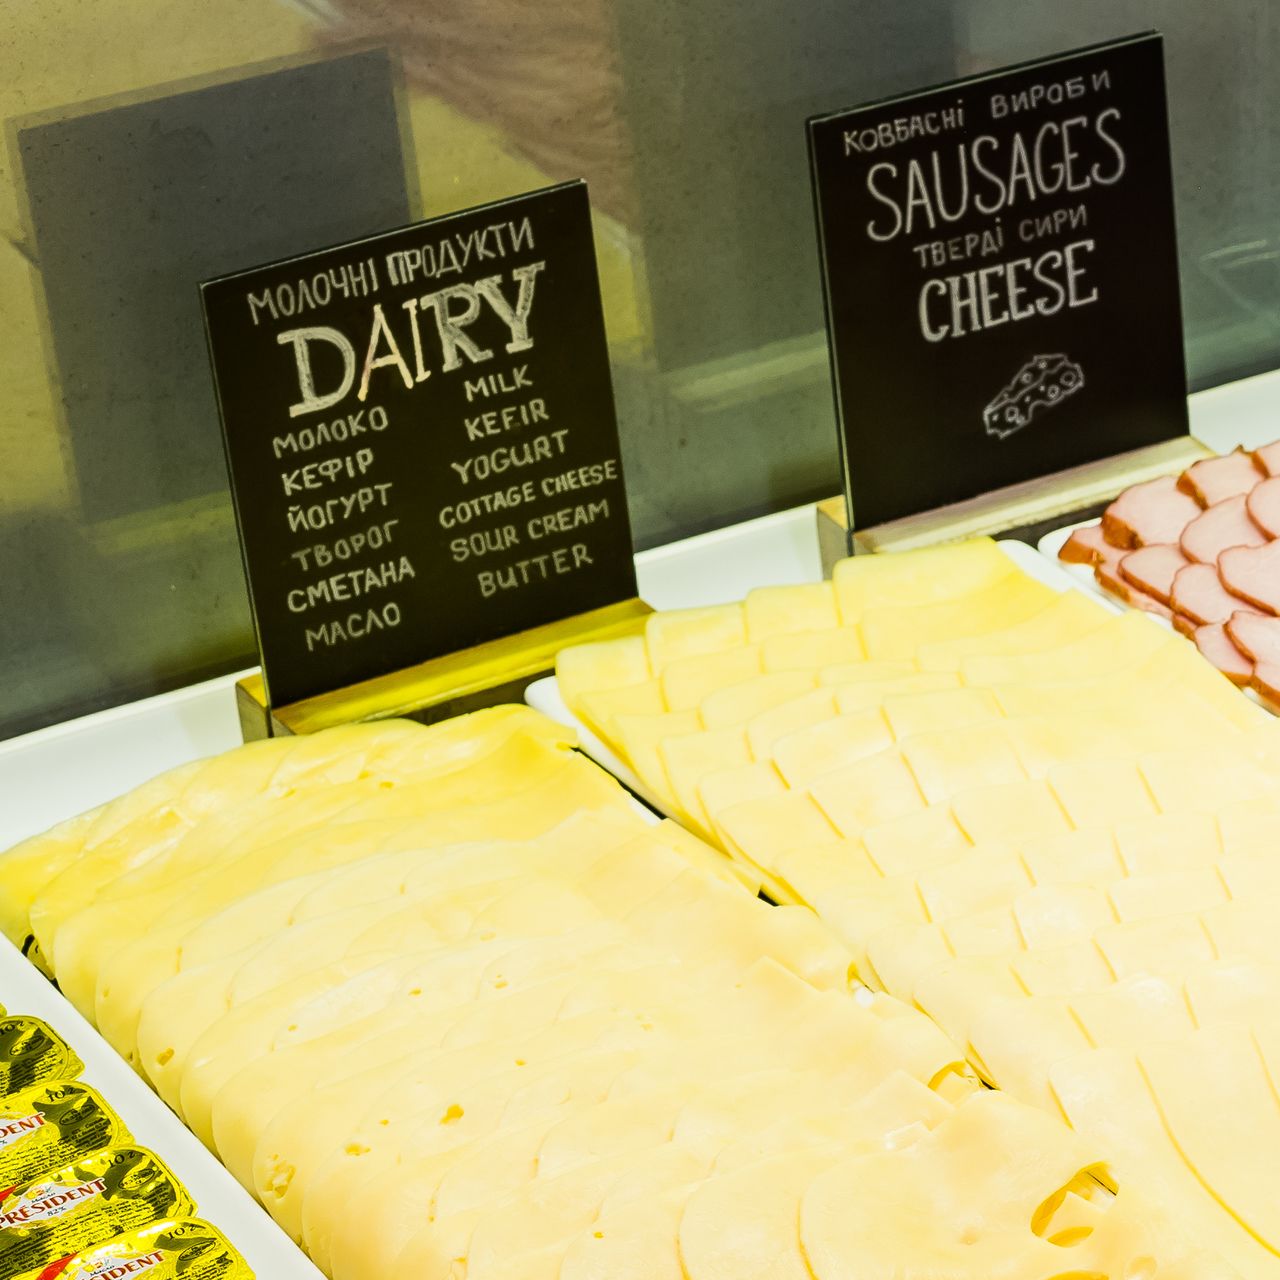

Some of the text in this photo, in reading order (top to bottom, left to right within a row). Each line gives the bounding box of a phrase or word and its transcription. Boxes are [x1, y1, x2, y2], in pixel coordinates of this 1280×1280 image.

[991, 70, 1111, 119] ВИРОБИ
[866, 107, 1126, 242] SAUSAGES
[1018, 204, 1088, 243] СИРИ
[247, 217, 536, 325] МОЛОЧНІ ПРОДУКТИ
[919, 239, 1099, 342] CHEESE
[276, 260, 546, 418] DAIRY
[464, 364, 534, 403] MILK
[272, 405, 389, 459] МОЛОКО
[464, 398, 550, 442] KEFIR
[281, 448, 374, 496] КЕФІР
[450, 429, 570, 486] YOGURT
[287, 482, 394, 534] ЙОГУРТ
[438, 459, 619, 530] COTTAGE CHEESE
[291, 519, 400, 572] ТВОРОГ
[449, 500, 610, 563] SOUR CREAM
[286, 555, 415, 613] СМЕТАНА
[478, 544, 593, 598] BUTTER
[305, 602, 401, 651] МАСЛО
[48, 1089, 66, 1103] 10
[107, 1153, 126, 1168] 10
[47, 1206, 66, 1217] 82%
[167, 1227, 186, 1240] 10
